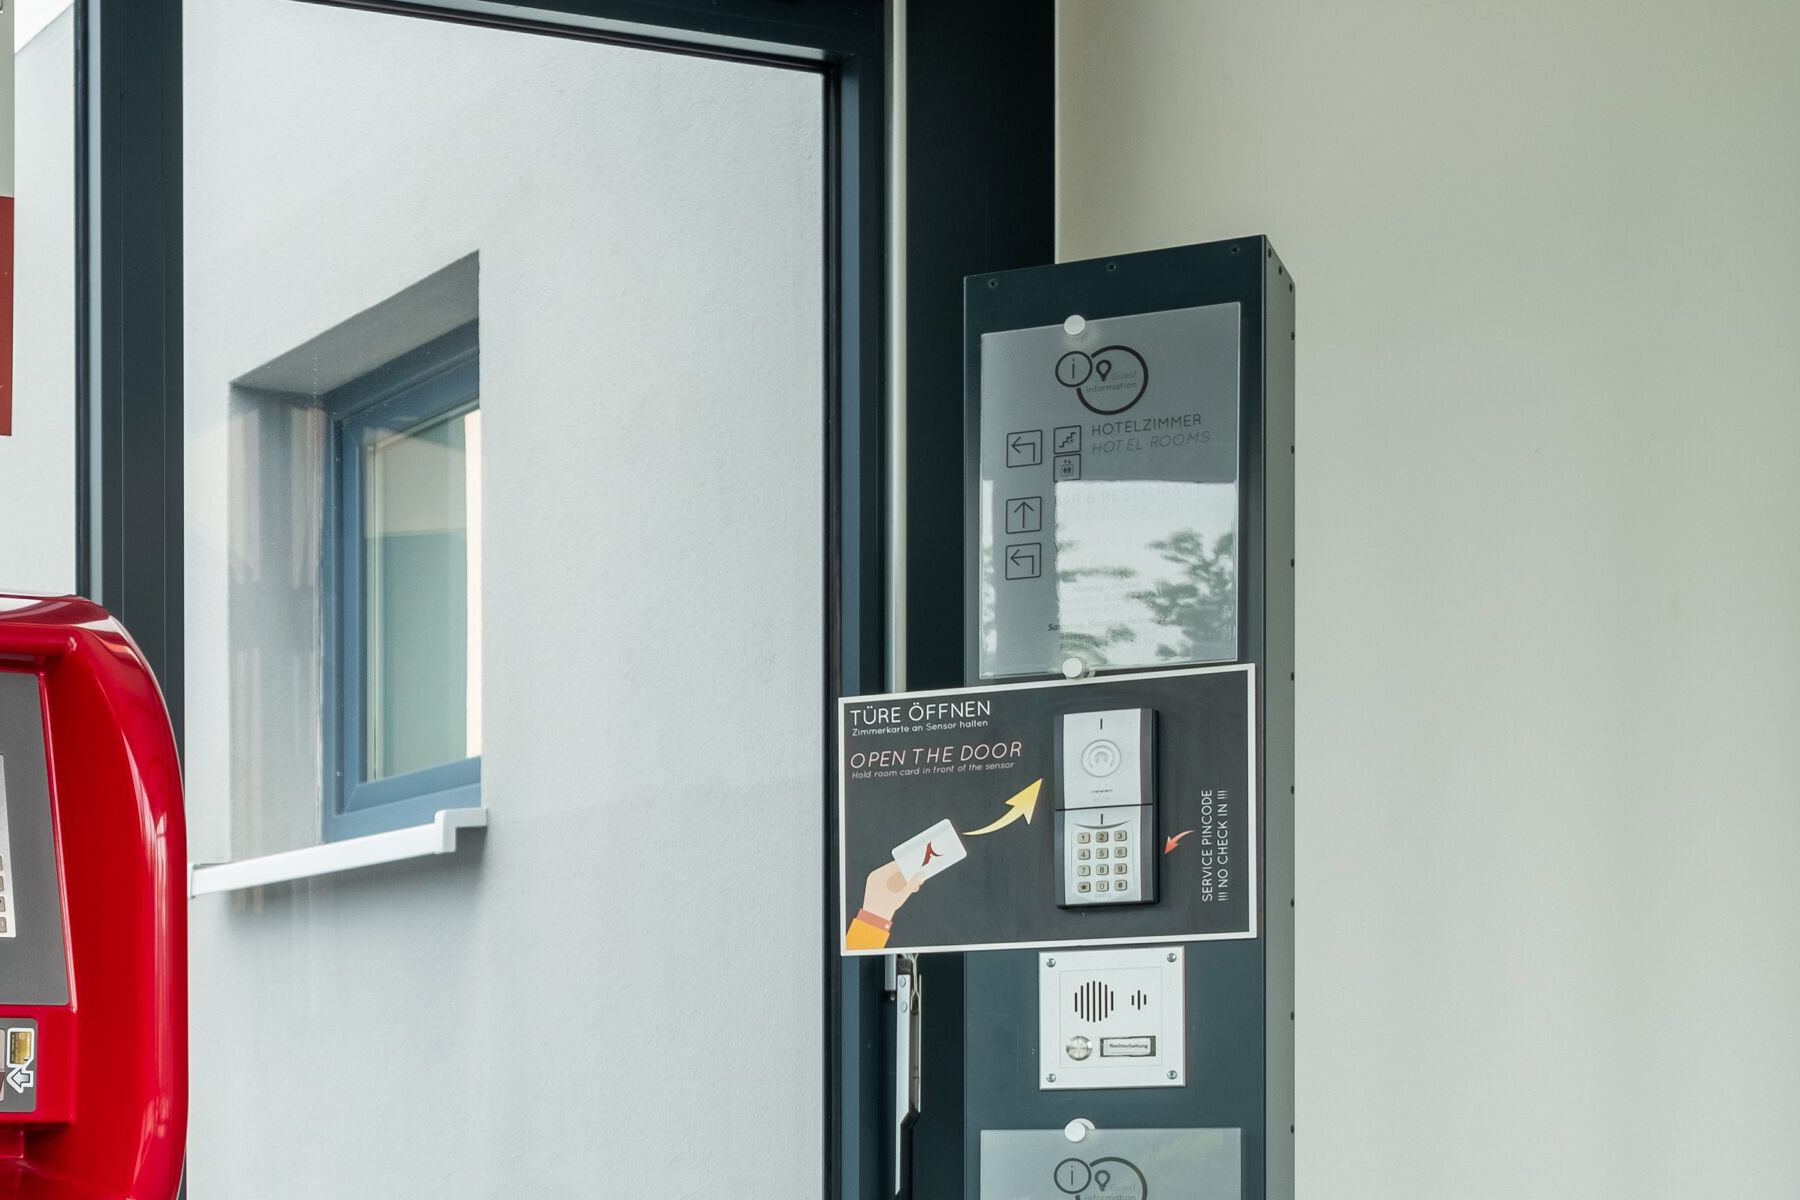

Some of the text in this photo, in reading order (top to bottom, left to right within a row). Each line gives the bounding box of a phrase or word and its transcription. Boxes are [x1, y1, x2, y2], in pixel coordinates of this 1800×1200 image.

[1092, 413, 1202, 436] HOTELZIMMER
[1091, 431, 1211, 454] HOTEL ROOMS
[850, 700, 991, 726] TÜRE ÖFFNEN
[852, 719, 988, 737] Zimmerkarte an Sensor halten
[850, 741, 1022, 769] OPEN THE DOOR
[851, 761, 1015, 779] Hold room card in front of the sensor
[1217, 803, 1229, 817] IN
[1202, 789, 1213, 902] SERVICE PINCODE
[1217, 820, 1229, 865] CHECK
[1217, 868, 1229, 888] NO
